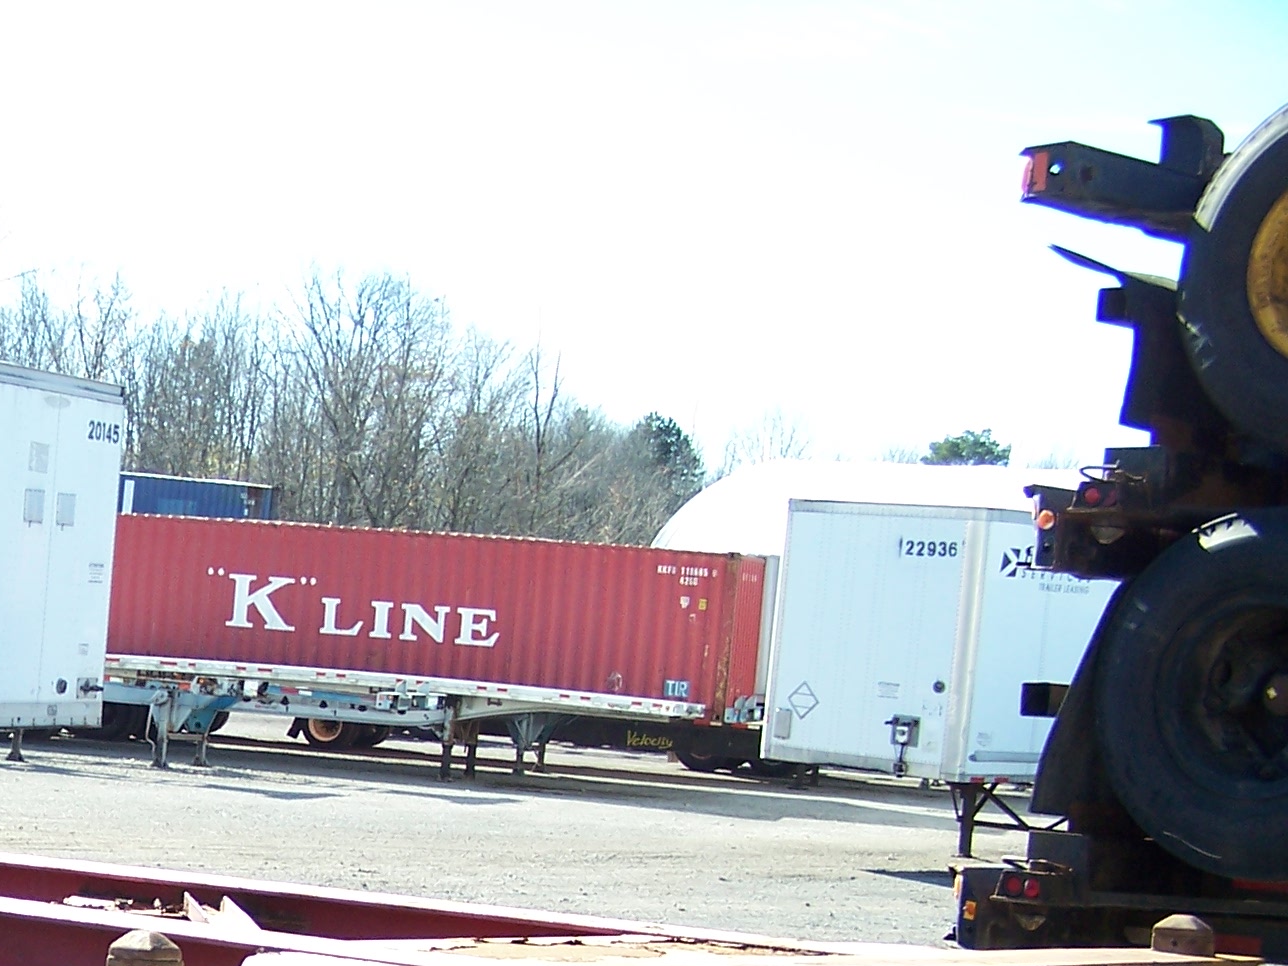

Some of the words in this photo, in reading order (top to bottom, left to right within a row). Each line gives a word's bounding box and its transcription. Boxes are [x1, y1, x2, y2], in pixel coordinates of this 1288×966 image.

[88, 420, 120, 444] 20145
[905, 540, 958, 557] 22936
[319, 597, 500, 647] LINE
[666, 680, 688, 697] TIR
[626, 730, 673, 749] Velocity
